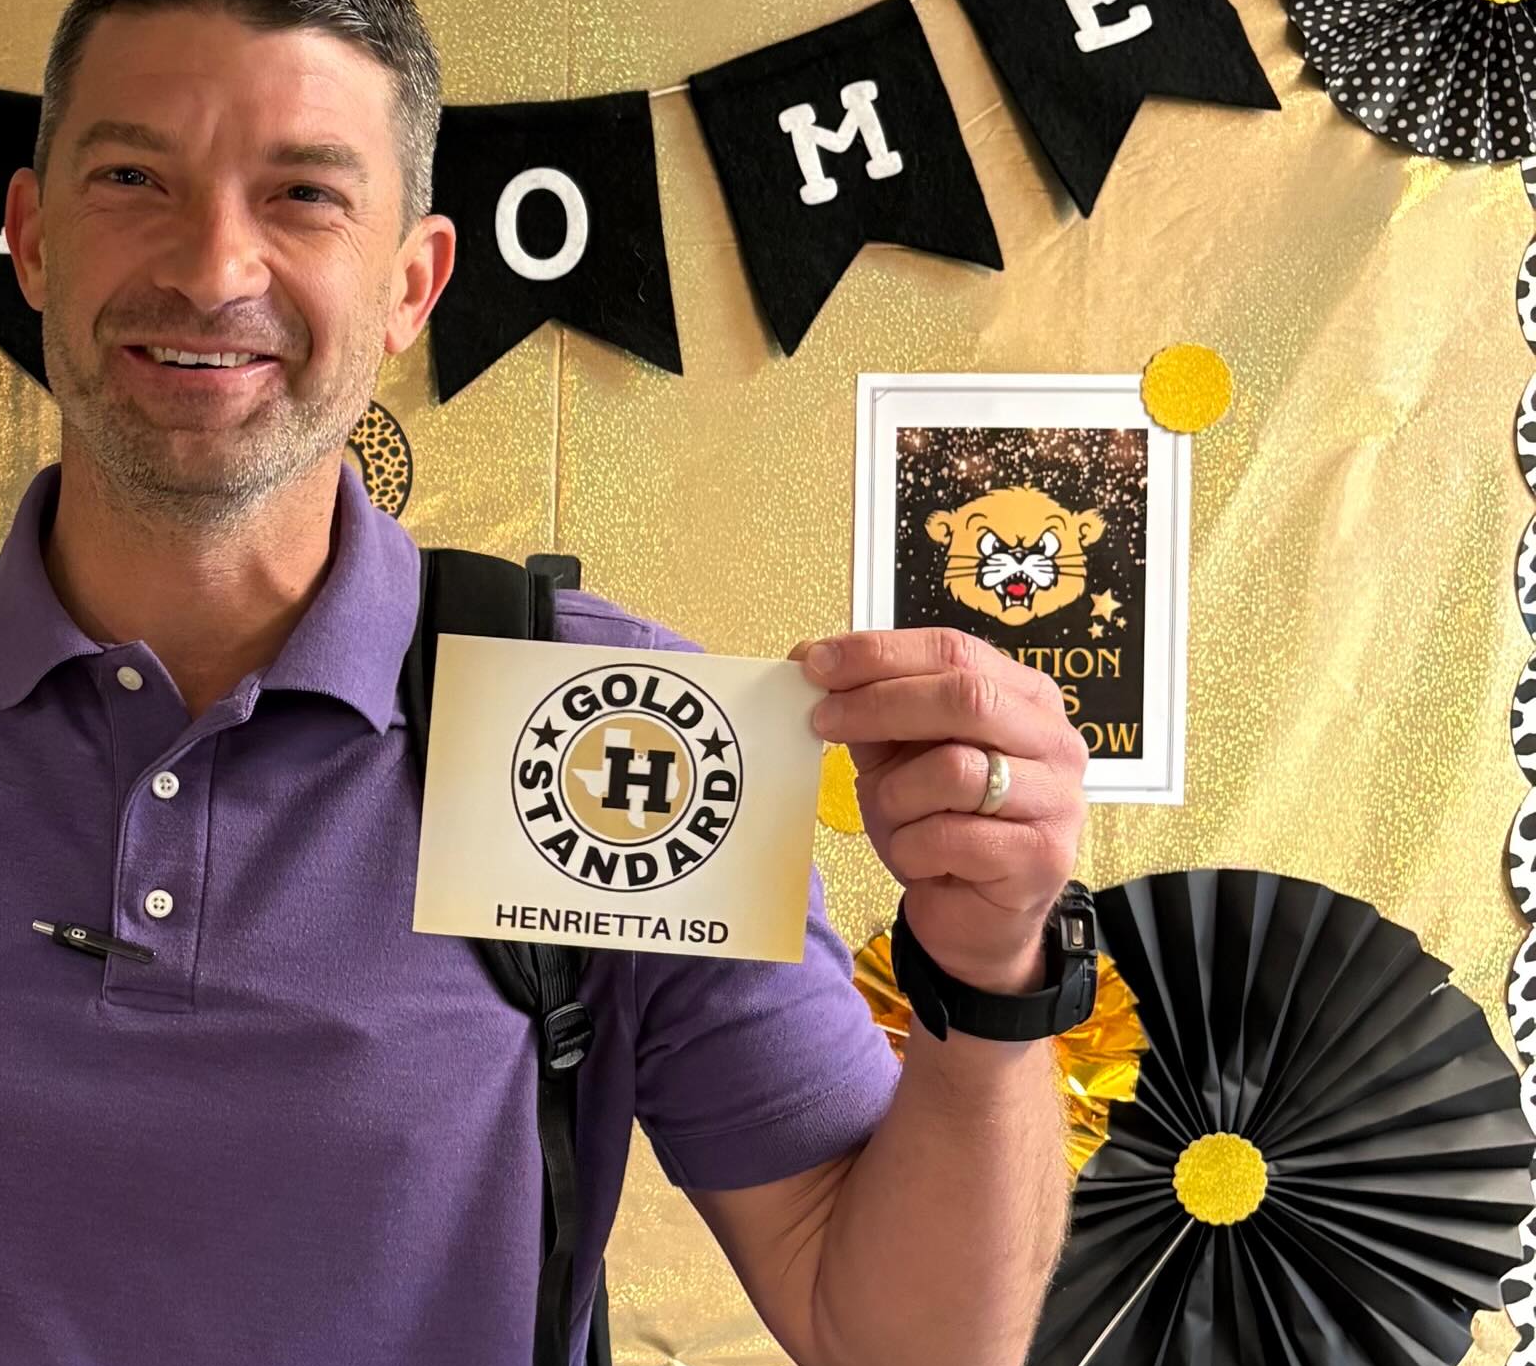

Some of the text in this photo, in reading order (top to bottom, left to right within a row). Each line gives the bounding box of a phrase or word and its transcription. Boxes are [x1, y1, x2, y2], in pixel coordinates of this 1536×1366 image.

[998, 647, 1122, 678] ITION
[563, 673, 705, 731] GOLD
[1060, 684, 1081, 716] S
[1077, 721, 1140, 753] OW
[601, 746, 676, 814] H
[519, 758, 737, 887] STANDARD
[496, 904, 729, 944] HENRIETTA ISD
